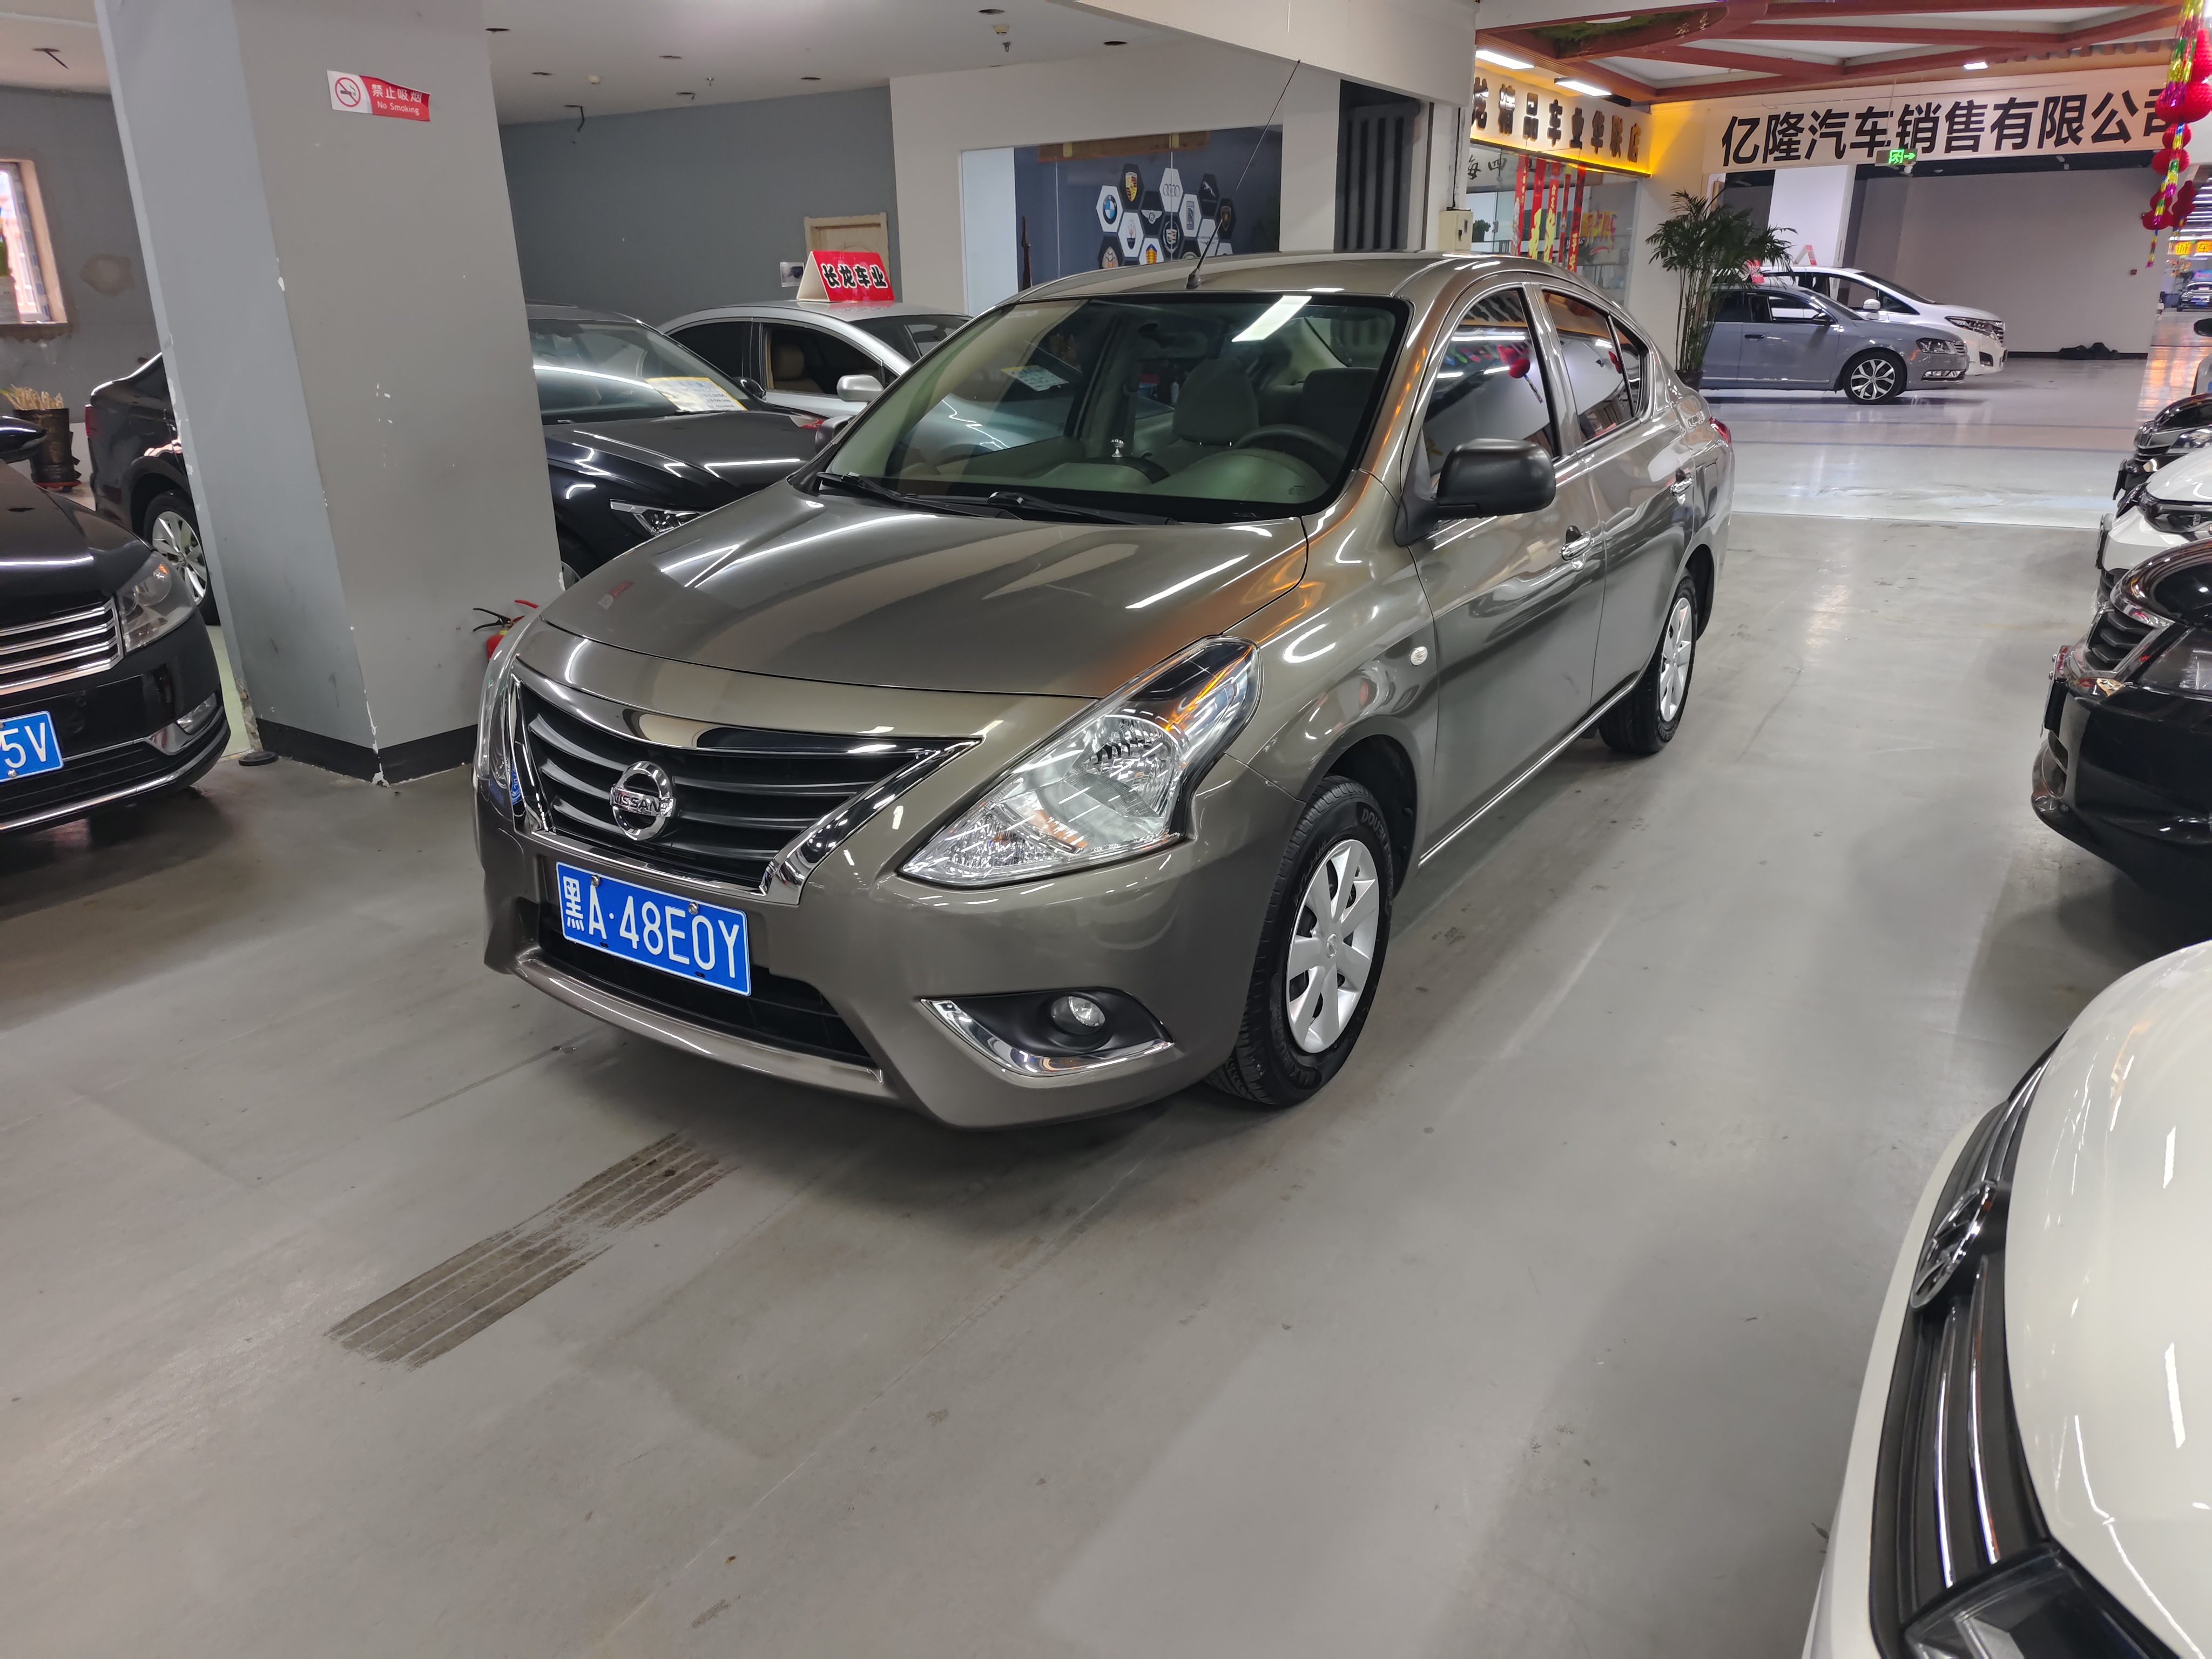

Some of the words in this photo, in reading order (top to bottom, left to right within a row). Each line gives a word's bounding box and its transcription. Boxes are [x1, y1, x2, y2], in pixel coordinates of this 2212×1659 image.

[372, 84, 422, 102] 禁止吸烟
[377, 101, 387, 110] No
[390, 103, 420, 116] Smoking
[820, 263, 888, 288] 长龙车业
[613, 793, 661, 813] NISSAN
